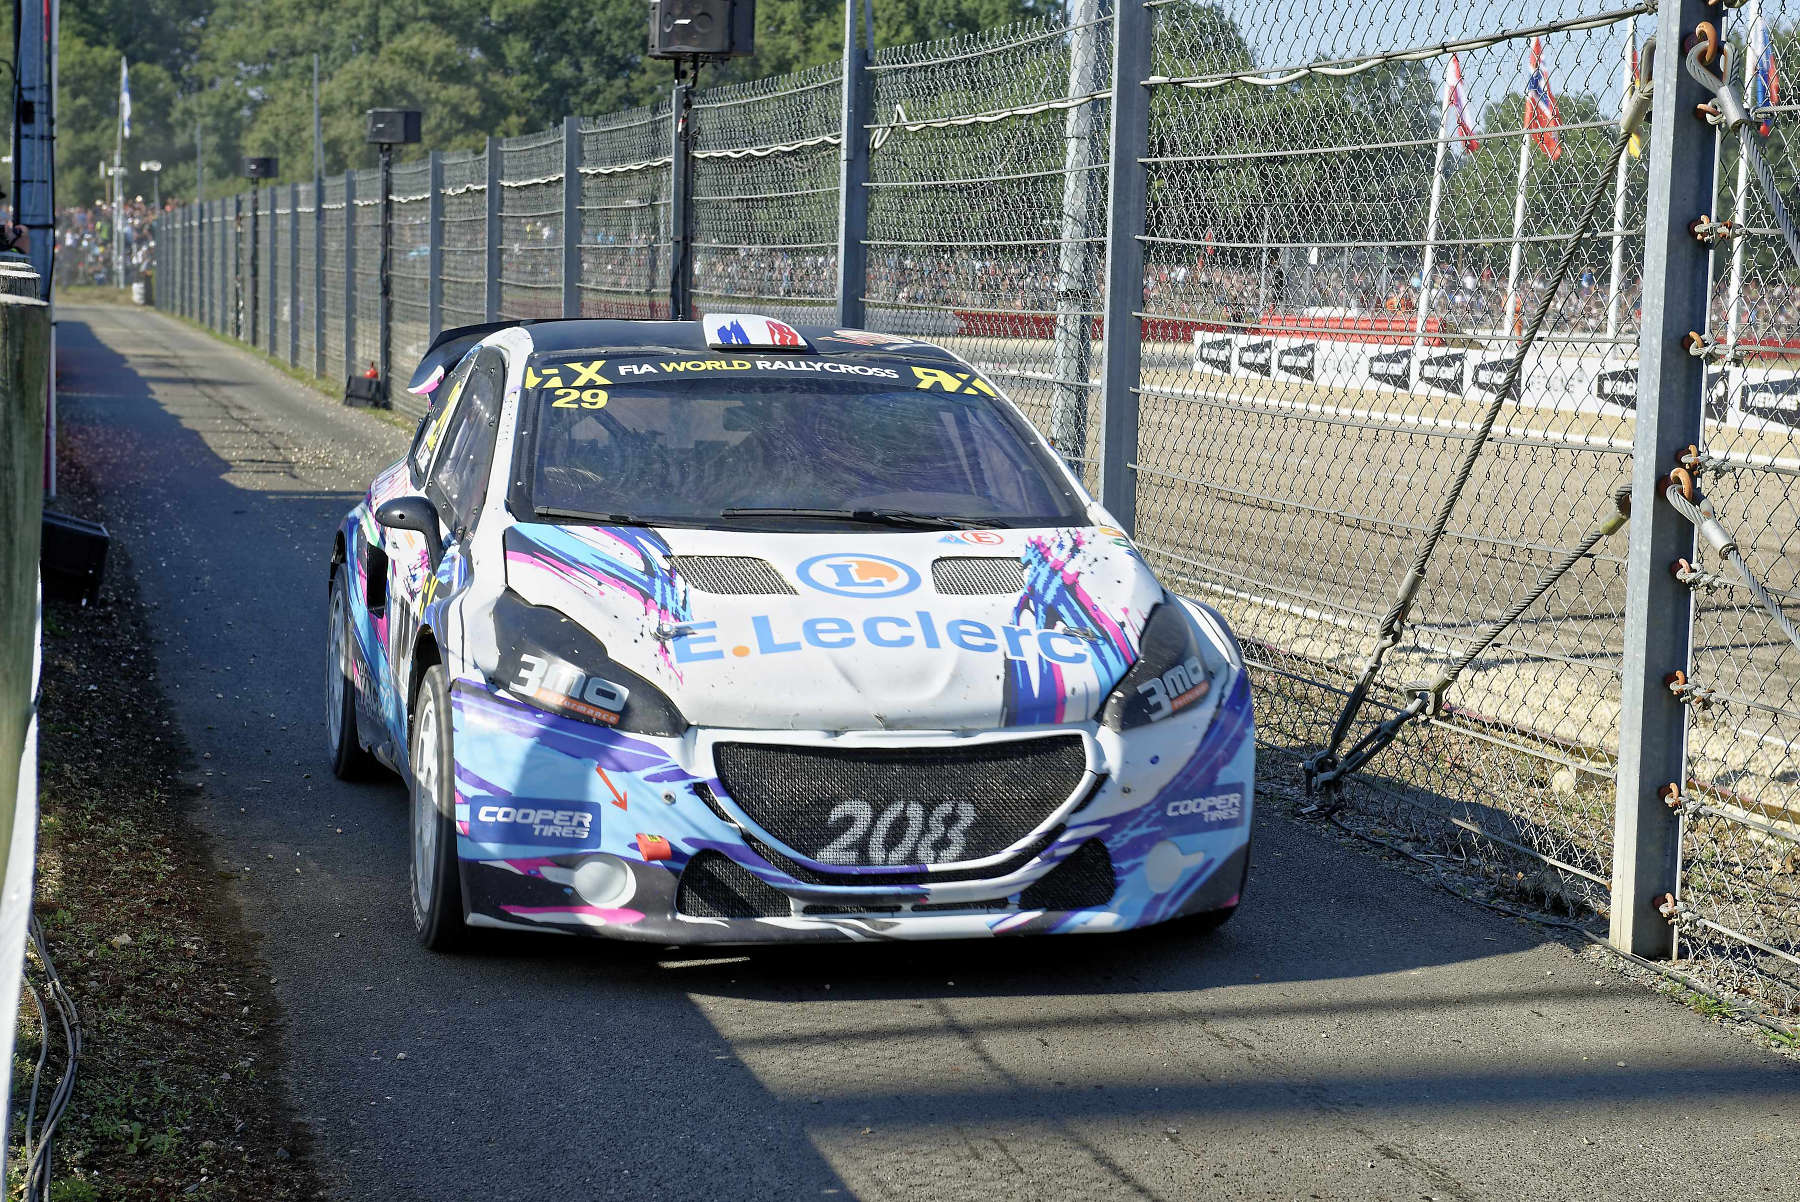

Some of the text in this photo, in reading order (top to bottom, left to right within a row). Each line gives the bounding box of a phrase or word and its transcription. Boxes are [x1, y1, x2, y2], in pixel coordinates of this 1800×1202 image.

[618, 359, 900, 379] FIA WORLD RALLYCROSS
[551, 388, 609, 410] 29
[672, 609, 1090, 665] E.Leclerc
[1166, 792, 1242, 817] COOPER
[1202, 807, 1241, 823] TIRES
[478, 805, 593, 828] COOPER
[532, 824, 591, 839] TIRES
[816, 799, 977, 865] 208
